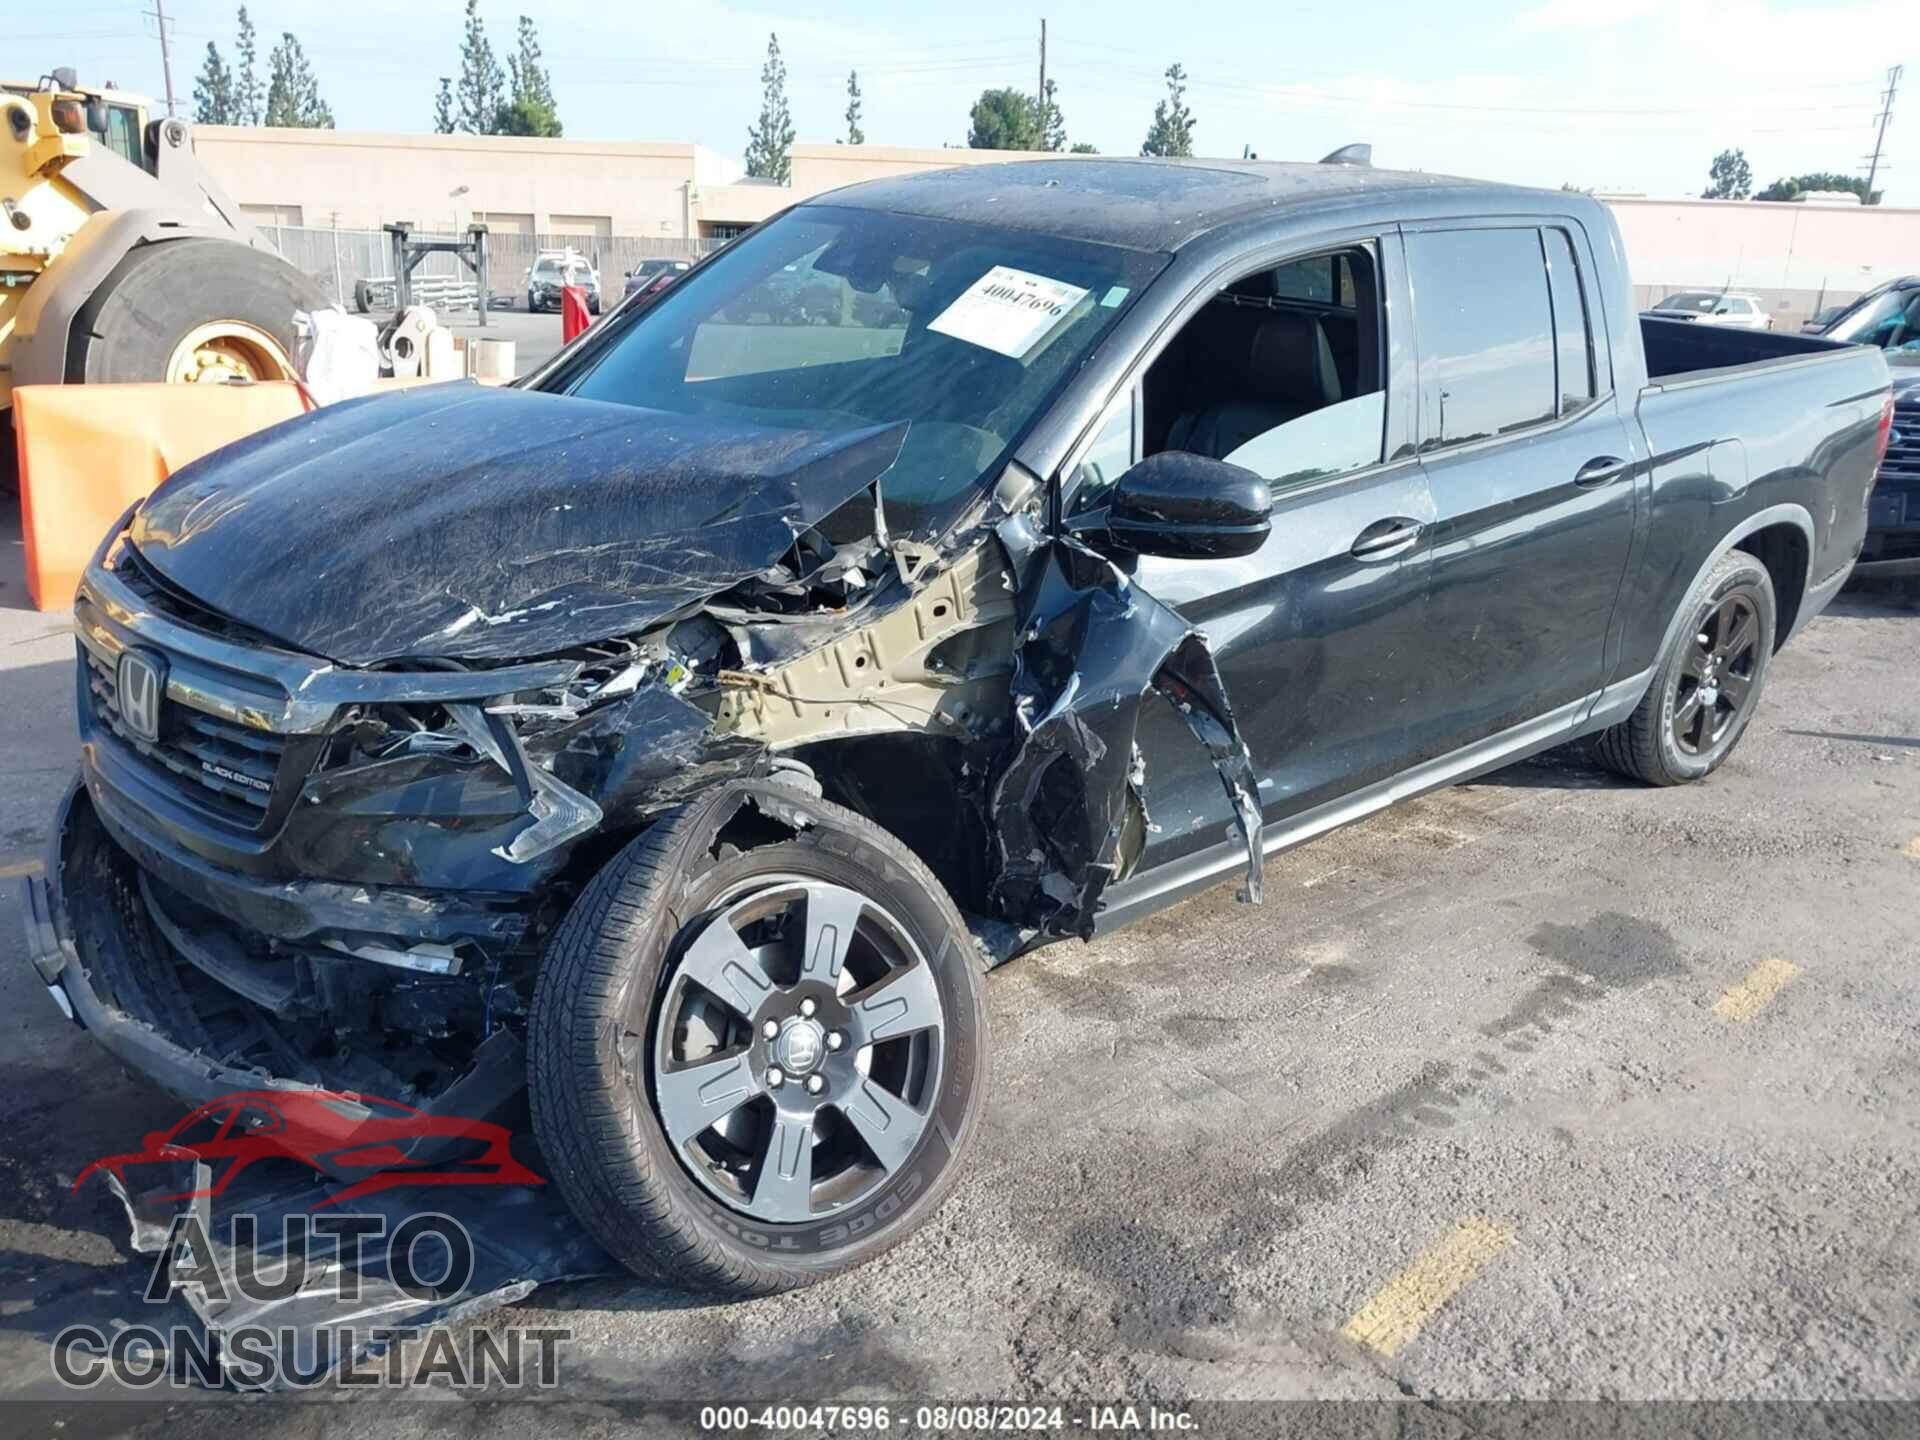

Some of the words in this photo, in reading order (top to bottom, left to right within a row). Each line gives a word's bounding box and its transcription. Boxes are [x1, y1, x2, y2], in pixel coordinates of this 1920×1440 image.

[982, 283, 1067, 316] 40047696
[202, 761, 233, 780] BLACK
[233, 772, 272, 791] EDITION
[819, 1170, 923, 1247] EDGE
